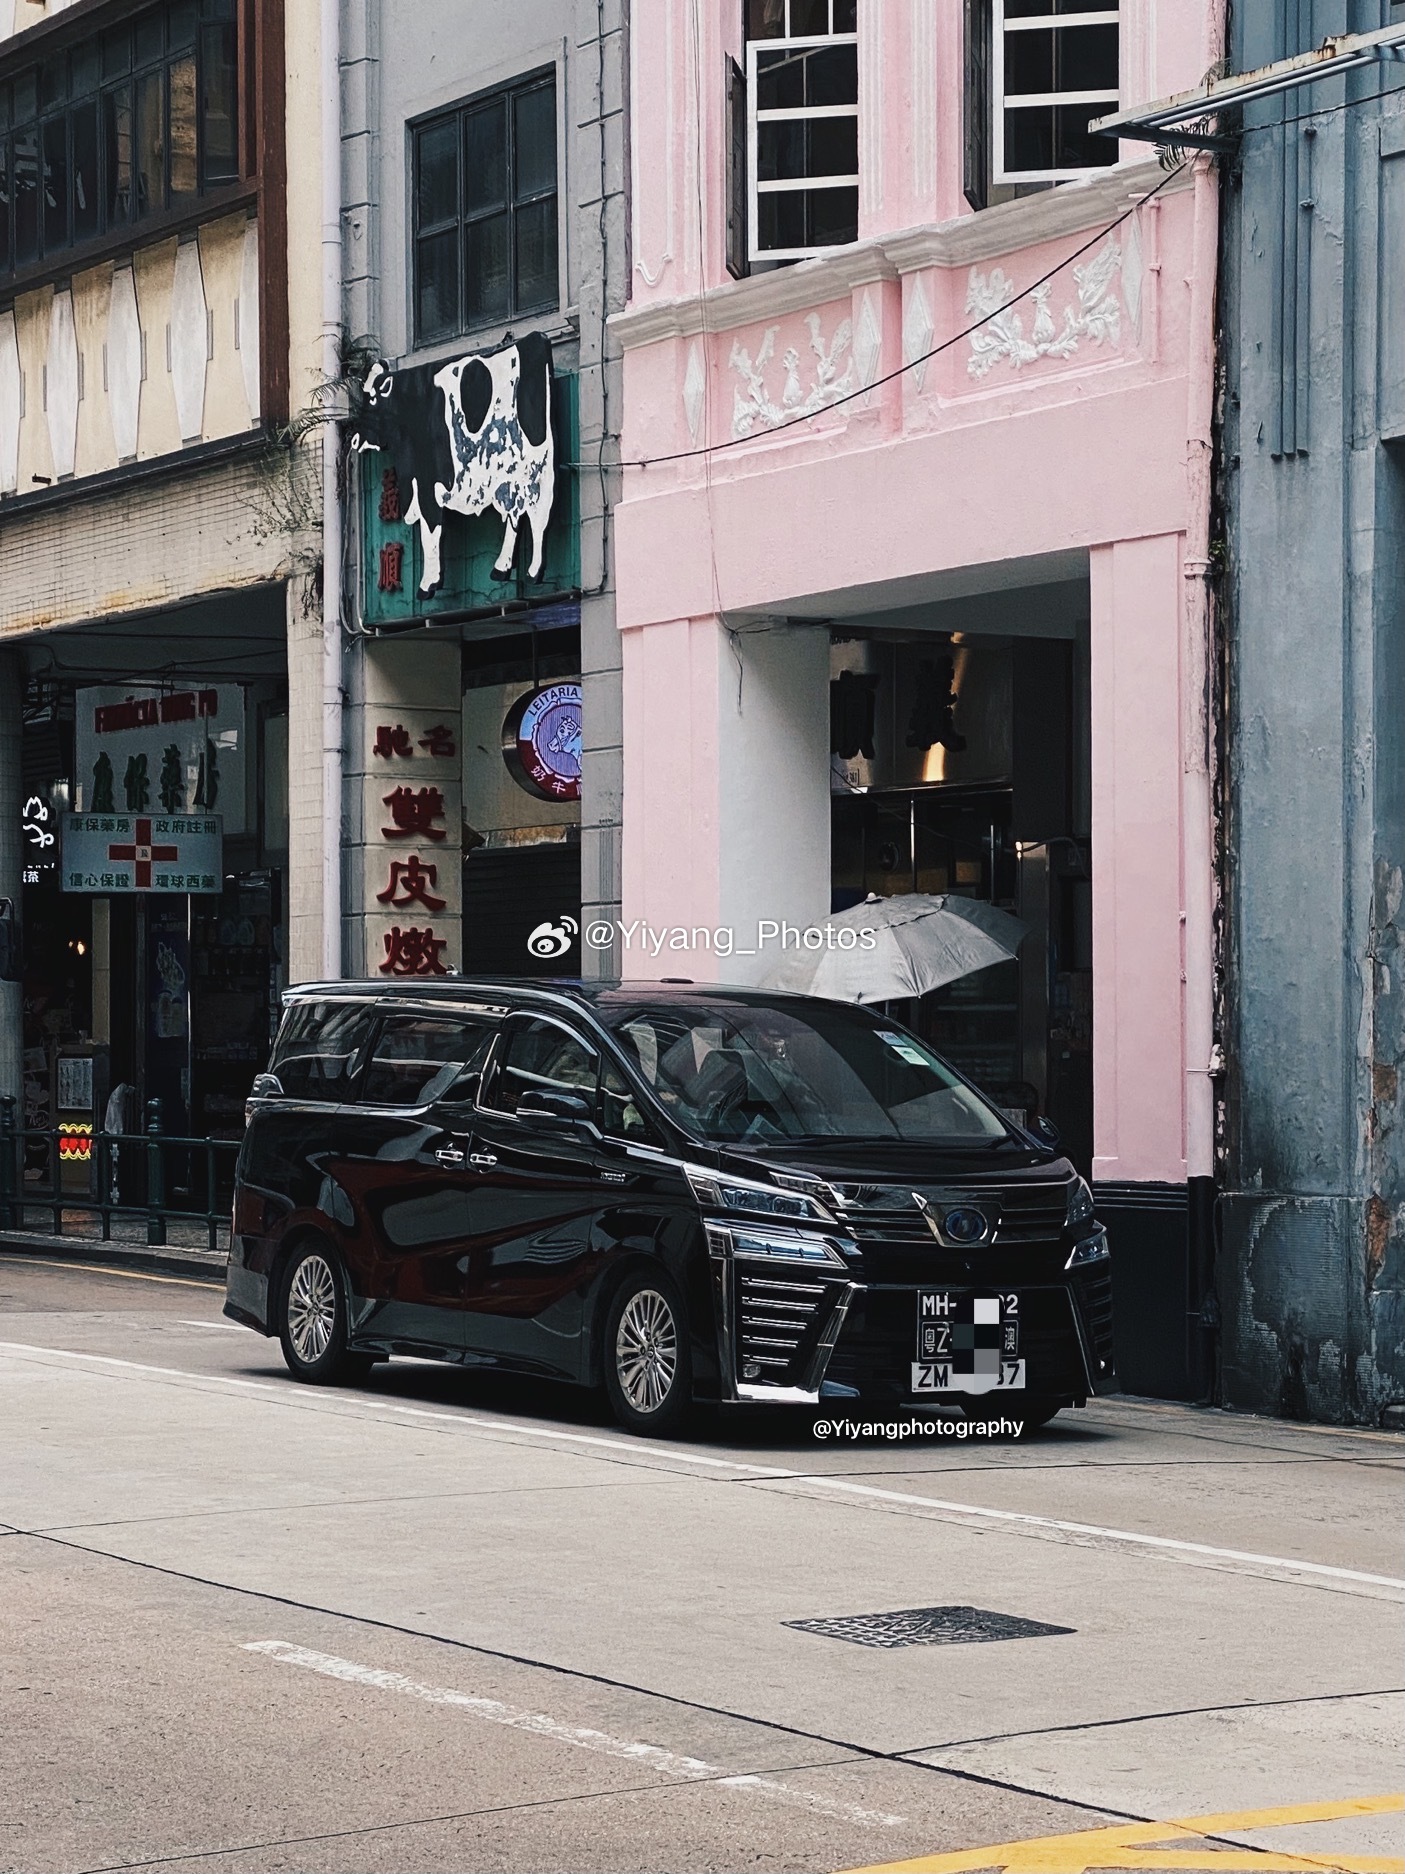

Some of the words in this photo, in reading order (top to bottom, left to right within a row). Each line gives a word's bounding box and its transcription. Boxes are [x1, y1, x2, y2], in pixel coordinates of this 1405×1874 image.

[528, 686, 579, 718] LEITARIA
[69, 817, 130, 833] 康保藥房
[155, 819, 217, 834] 政府註冊
[69, 872, 130, 888] 信心保證
[155, 873, 216, 889] 環球西藥
